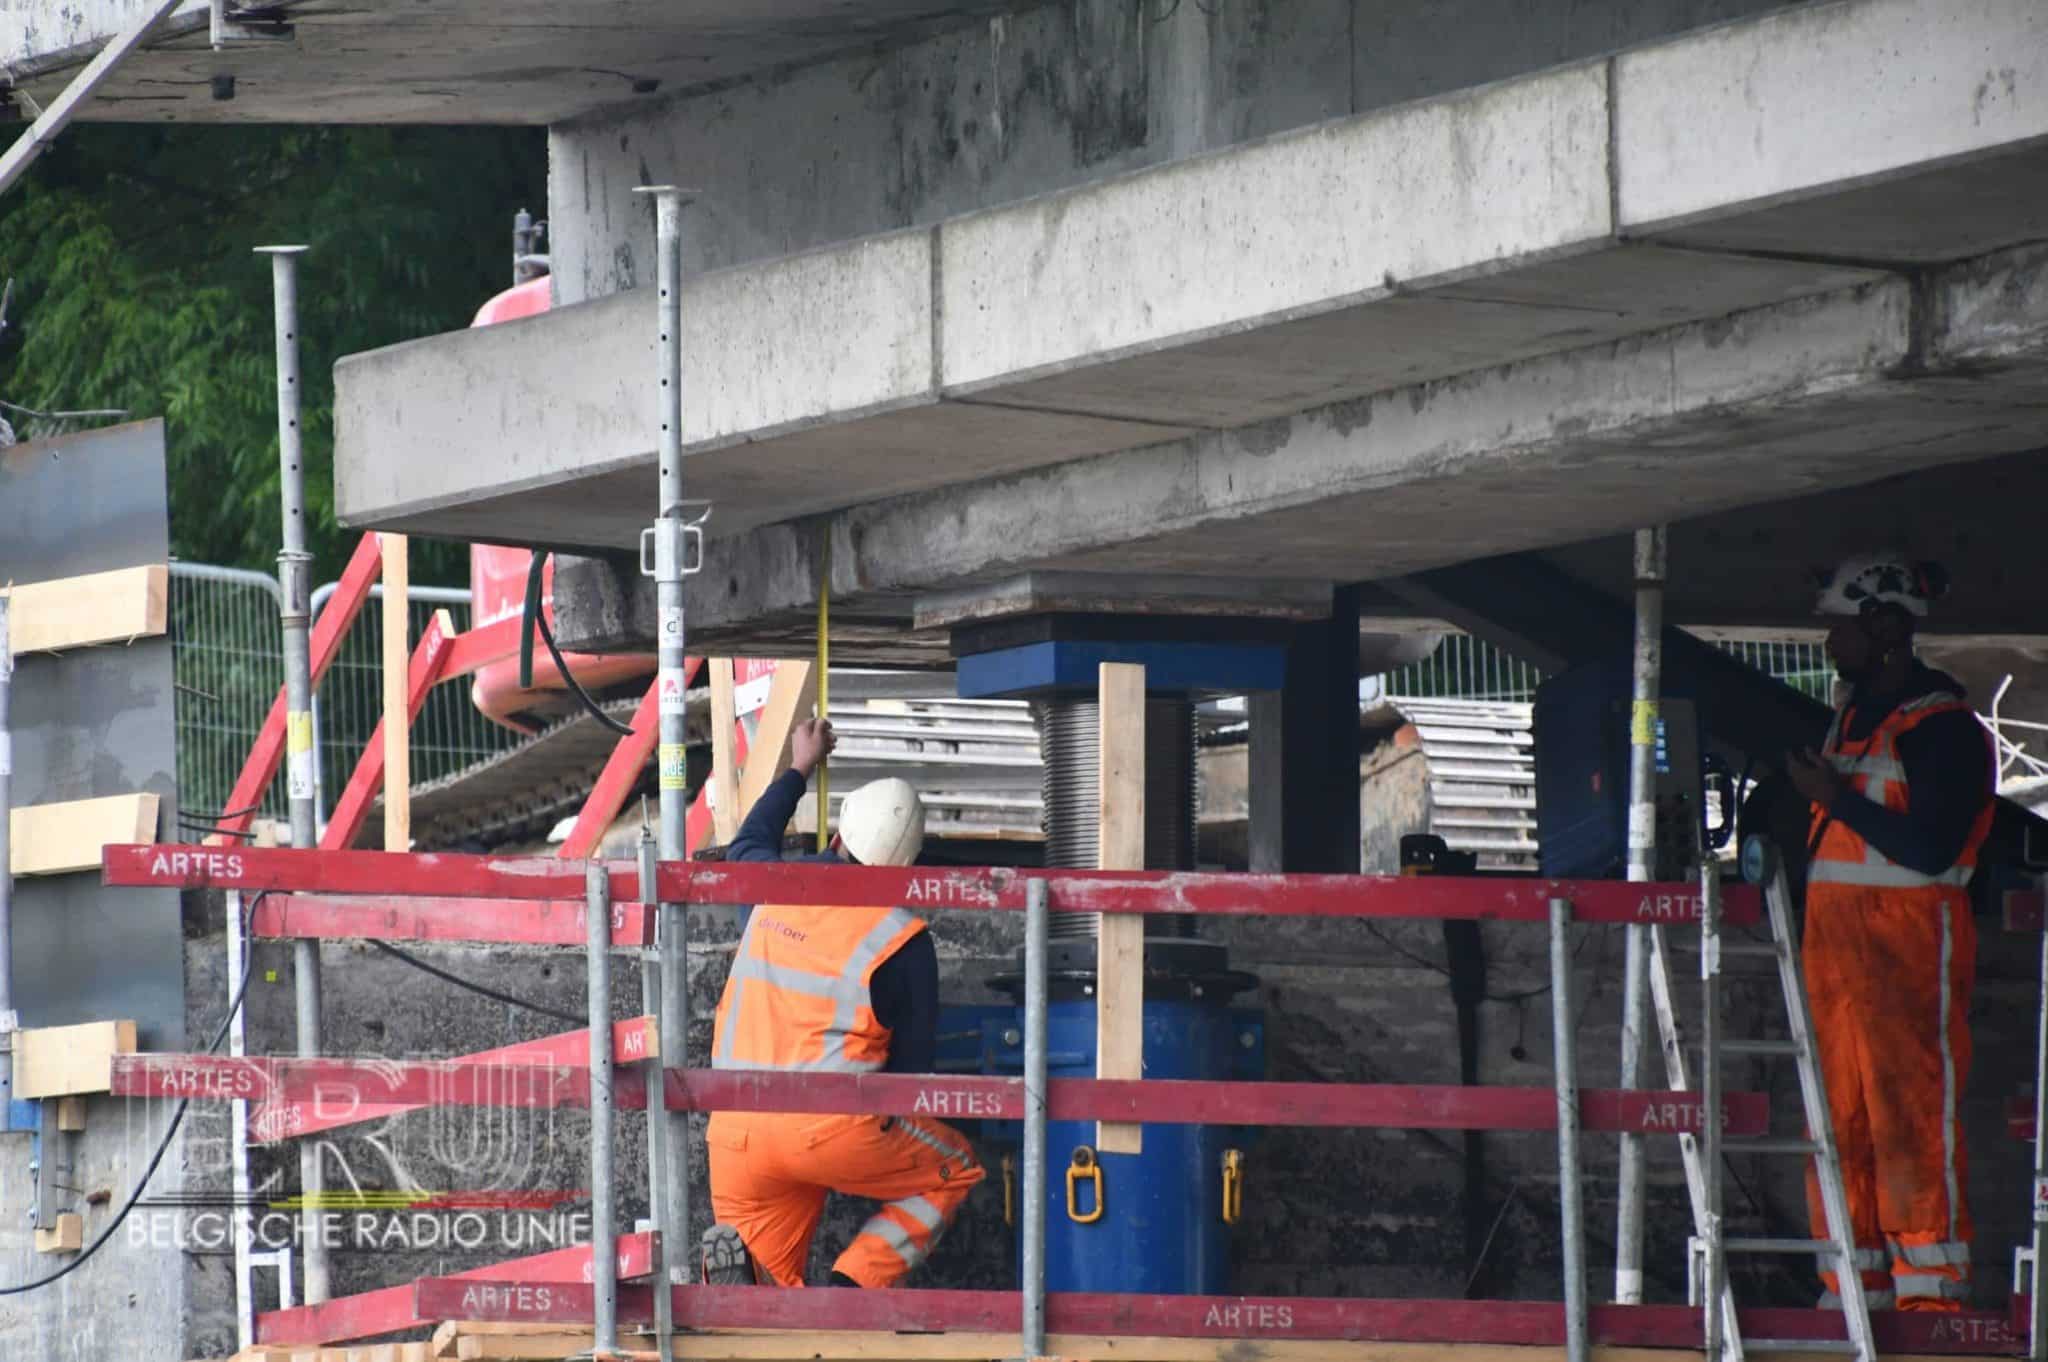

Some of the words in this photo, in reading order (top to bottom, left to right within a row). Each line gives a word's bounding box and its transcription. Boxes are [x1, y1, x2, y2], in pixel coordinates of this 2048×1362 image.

[151, 854, 243, 878] ARTES
[161, 1069, 252, 1093] ARTES
[913, 1090, 1003, 1115] ARTES
[461, 1286, 552, 1312] ARTES
[1205, 1304, 1294, 1329] ARTES
